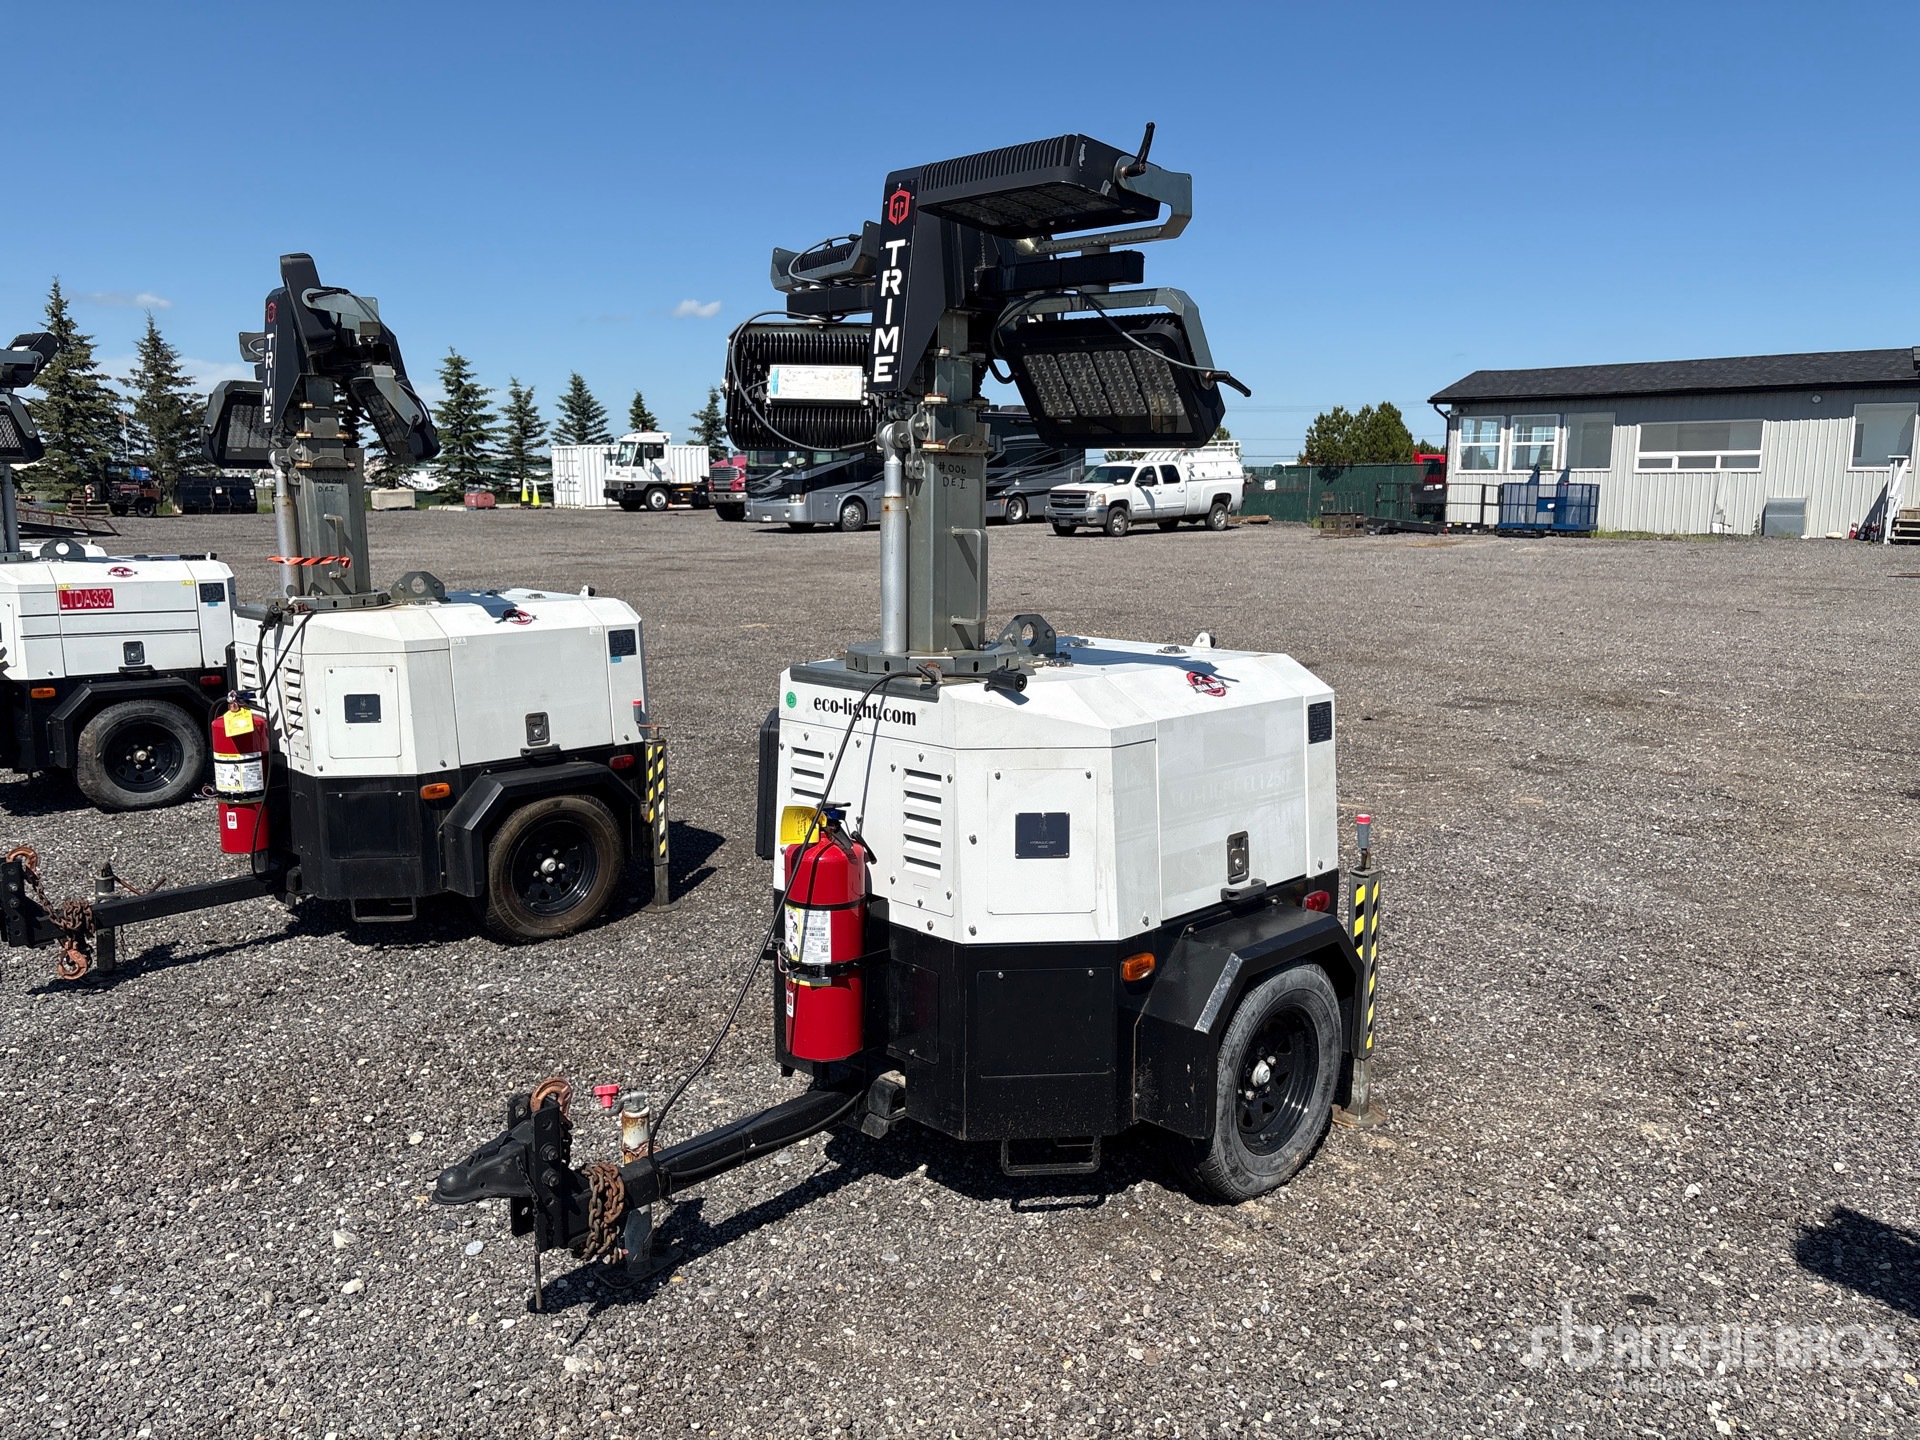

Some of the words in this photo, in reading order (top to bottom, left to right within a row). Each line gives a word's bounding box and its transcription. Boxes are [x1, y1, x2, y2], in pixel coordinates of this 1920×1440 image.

[873, 238, 907, 384] TRIME
[263, 332, 275, 424] TRIME
[60, 588, 114, 609] LTDA332
[813, 696, 917, 726] eco-light.com
